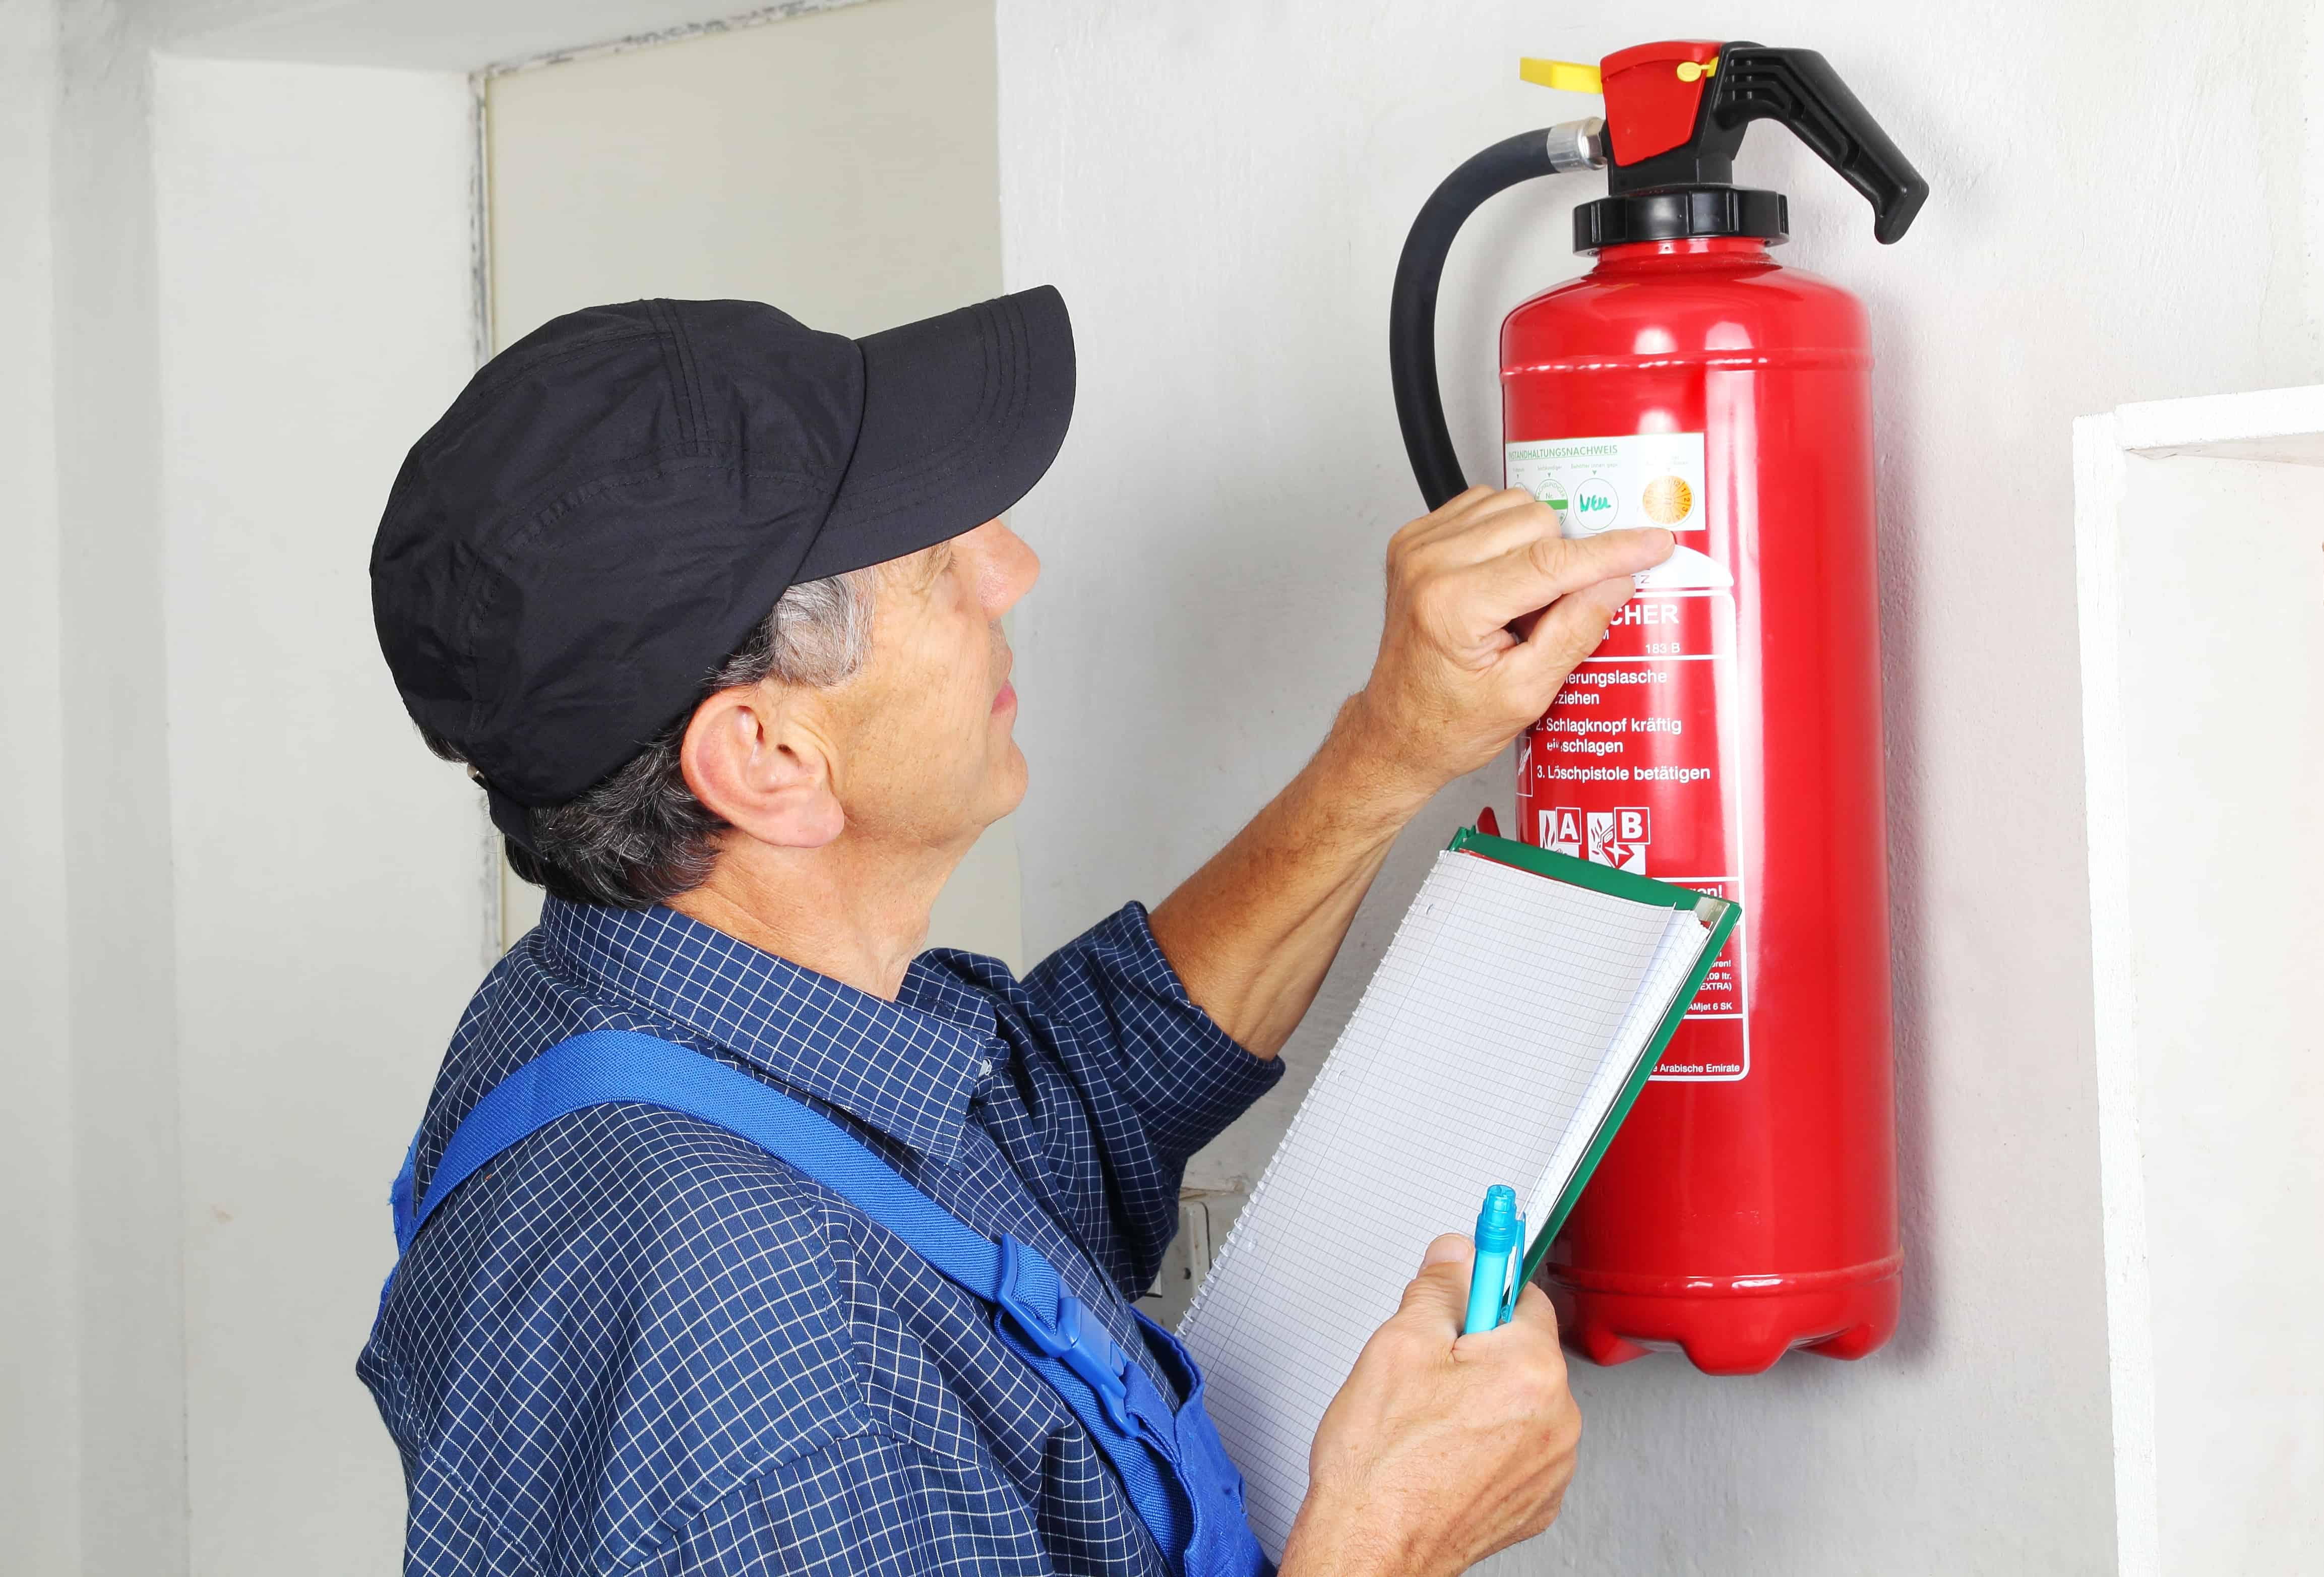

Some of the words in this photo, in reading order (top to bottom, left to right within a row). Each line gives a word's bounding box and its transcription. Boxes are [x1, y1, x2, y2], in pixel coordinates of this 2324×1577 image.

[1645, 643, 1667, 654] 183
[1671, 643, 1680, 653] B
[1555, 690, 1600, 705] ziehen
[1546, 717, 1627, 736] Schlagknopf
[1631, 717, 1682, 735] kräftig
[1537, 765, 1545, 778] 3.
[1548, 765, 1629, 783] Löschpistole
[1634, 766, 1710, 783] betätigen
[1559, 813, 1579, 840] A
[1621, 812, 1643, 839] B
[1713, 1002, 1718, 1010] 6
[1720, 1002, 1733, 1010] SK
[1660, 1063, 1704, 1073] Arabische
[1706, 1063, 1740, 1073] Emirate
